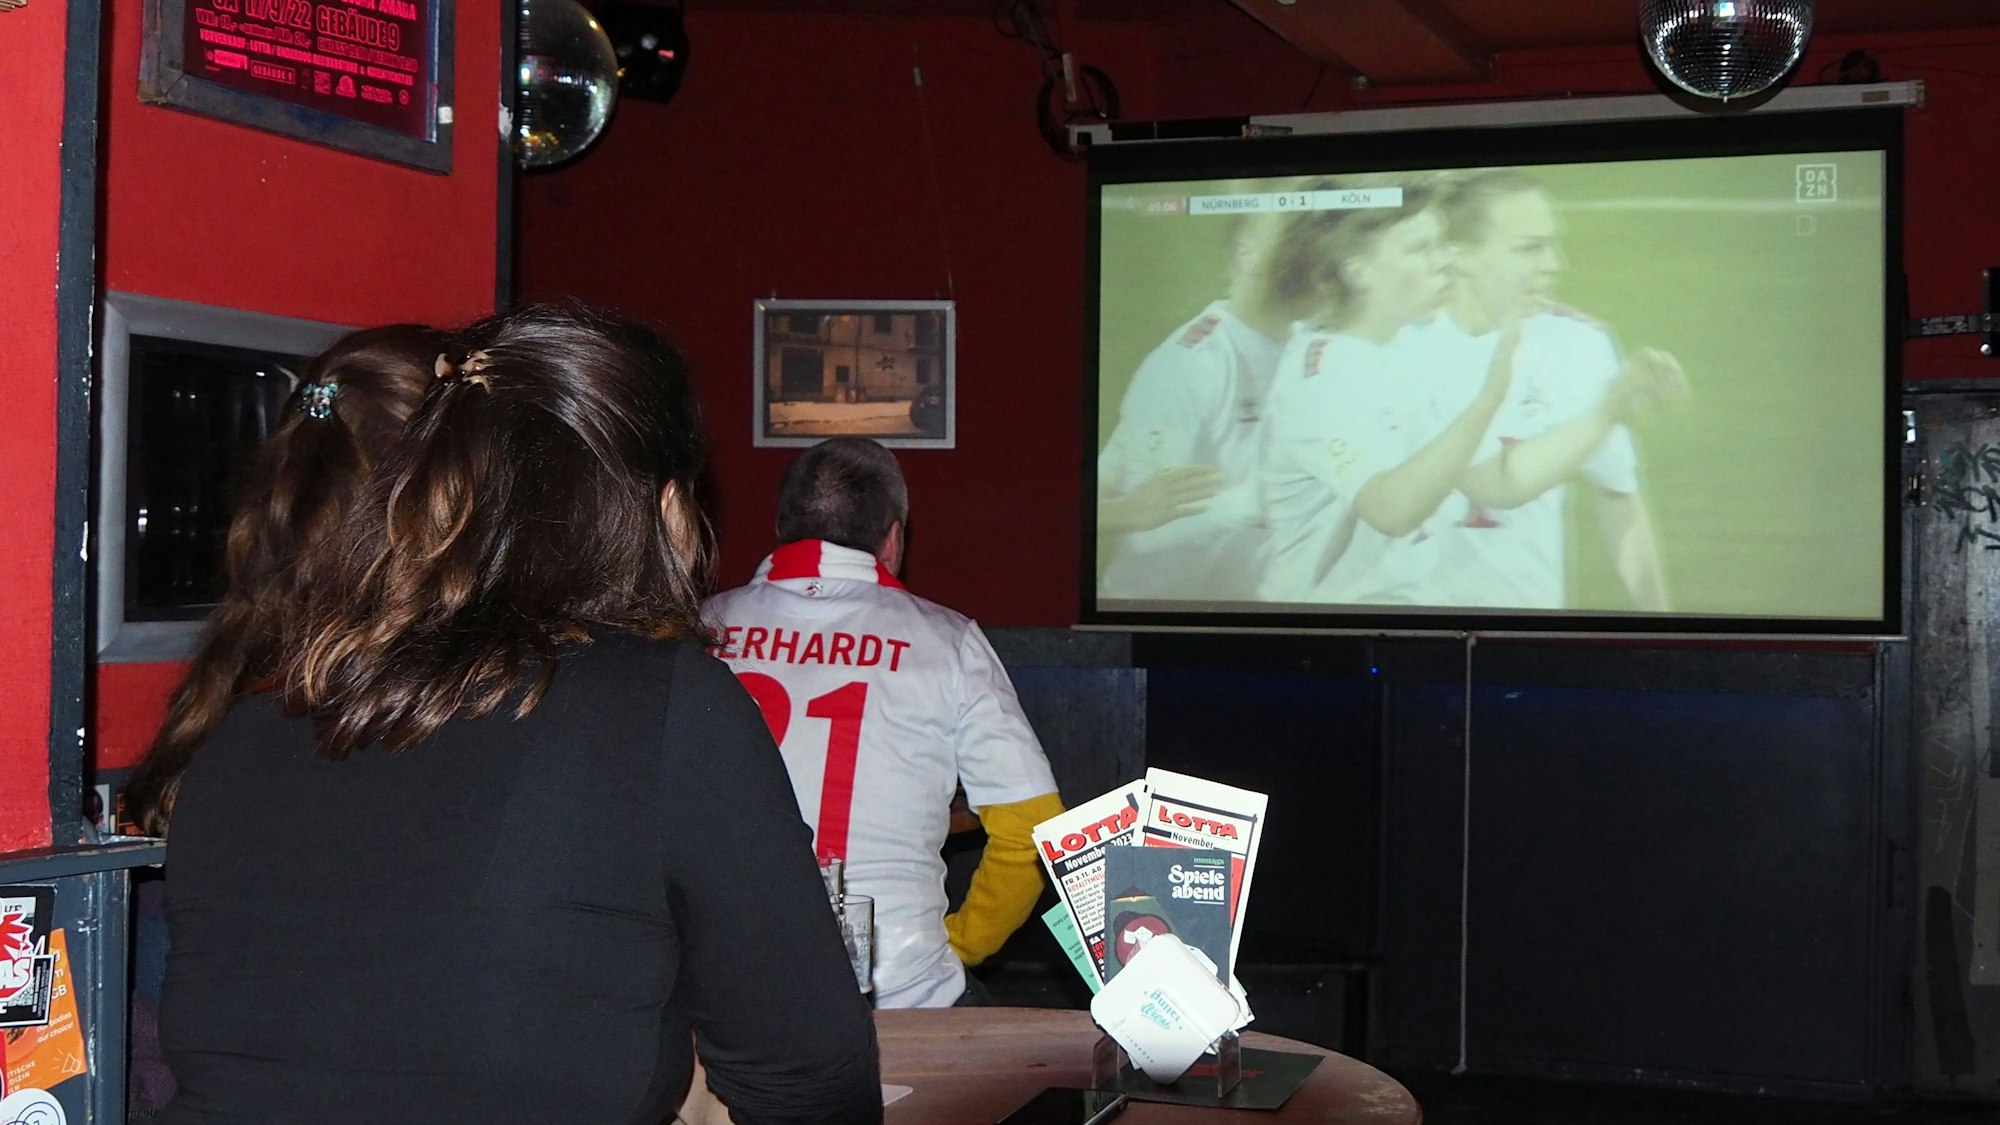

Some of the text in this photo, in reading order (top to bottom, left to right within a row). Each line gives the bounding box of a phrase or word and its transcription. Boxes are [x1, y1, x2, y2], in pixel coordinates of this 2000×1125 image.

[316, 5, 387, 48] GEBÄUDE
[388, 23, 400, 51] 9
[1202, 197, 1260, 210] NÜRNBERG
[1278, 196, 1287, 207] 0
[1299, 196, 1306, 206] 1
[1341, 193, 1371, 205] KÖLN
[1158, 804, 1238, 840] LOTTA
[1042, 805, 1139, 861] LOTTA
[1171, 831, 1214, 849] November
[1064, 846, 1106, 871] Novembe
[1067, 872, 1105, 892] ROYALTYMUSI
[1168, 864, 1225, 887] Spiele
[1172, 883, 1225, 901] abend
[9, 1060, 36, 1077] ITISCHE
[9, 1071, 31, 1086] DIZIN
